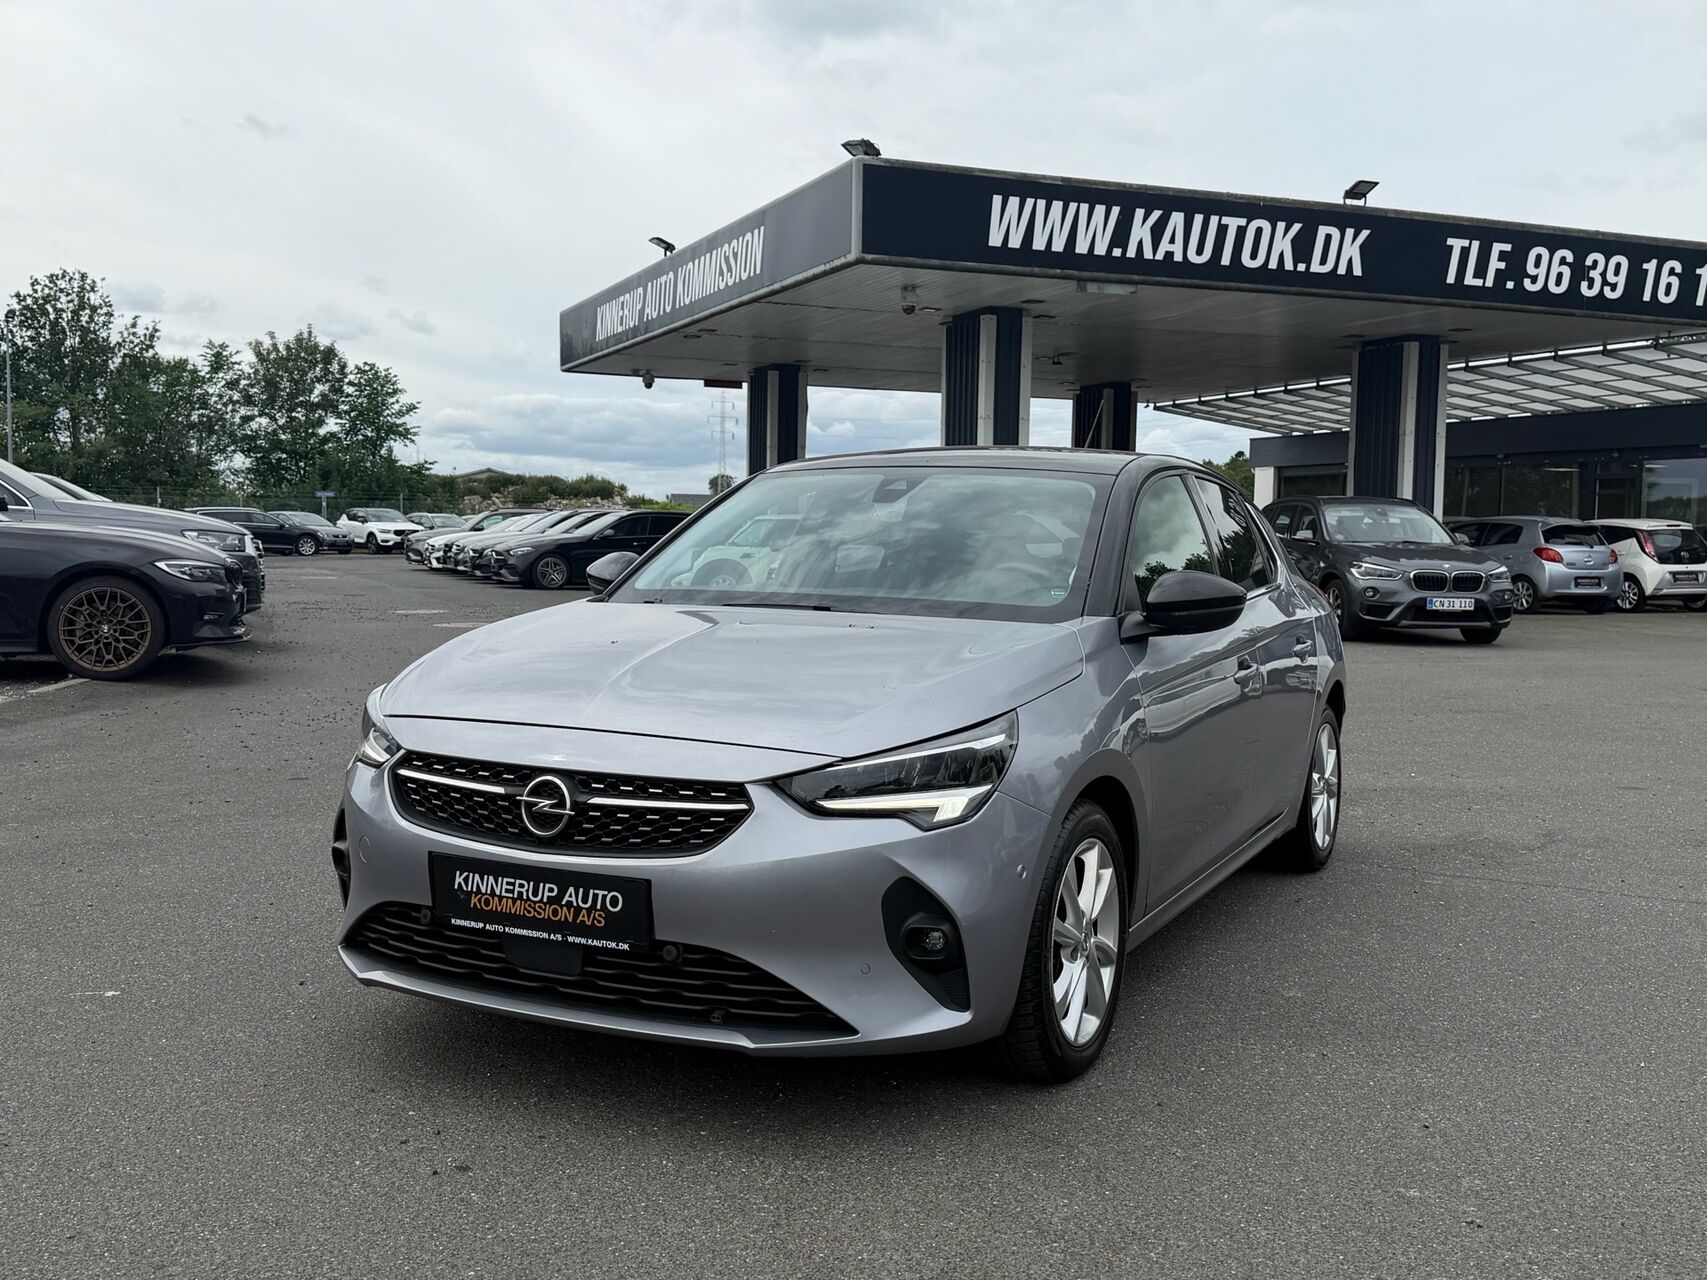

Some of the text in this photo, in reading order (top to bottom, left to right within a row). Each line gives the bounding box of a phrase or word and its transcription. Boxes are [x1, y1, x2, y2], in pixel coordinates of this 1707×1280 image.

[988, 194, 1371, 277] WWW.KAUTOK.DK
[596, 226, 765, 342] KINNERUP AUTO KOMMISSION
[1446, 238, 1515, 290] TLF.
[1523, 246, 1574, 294] 96
[1580, 252, 1629, 300] 39
[1642, 259, 1683, 304] 16
[1433, 600, 1473, 608] CN 31 110
[454, 870, 623, 912] KINNERUP AUTO
[470, 893, 606, 927] KOMMISSION A/S
[451, 918, 485, 930] KINNERUP
[485, 922, 504, 932] AUTO
[505, 925, 549, 940] KOMMISSION
[550, 933, 562, 941] A/S
[567, 935, 630, 950] WWW.KAUTOK.DK
